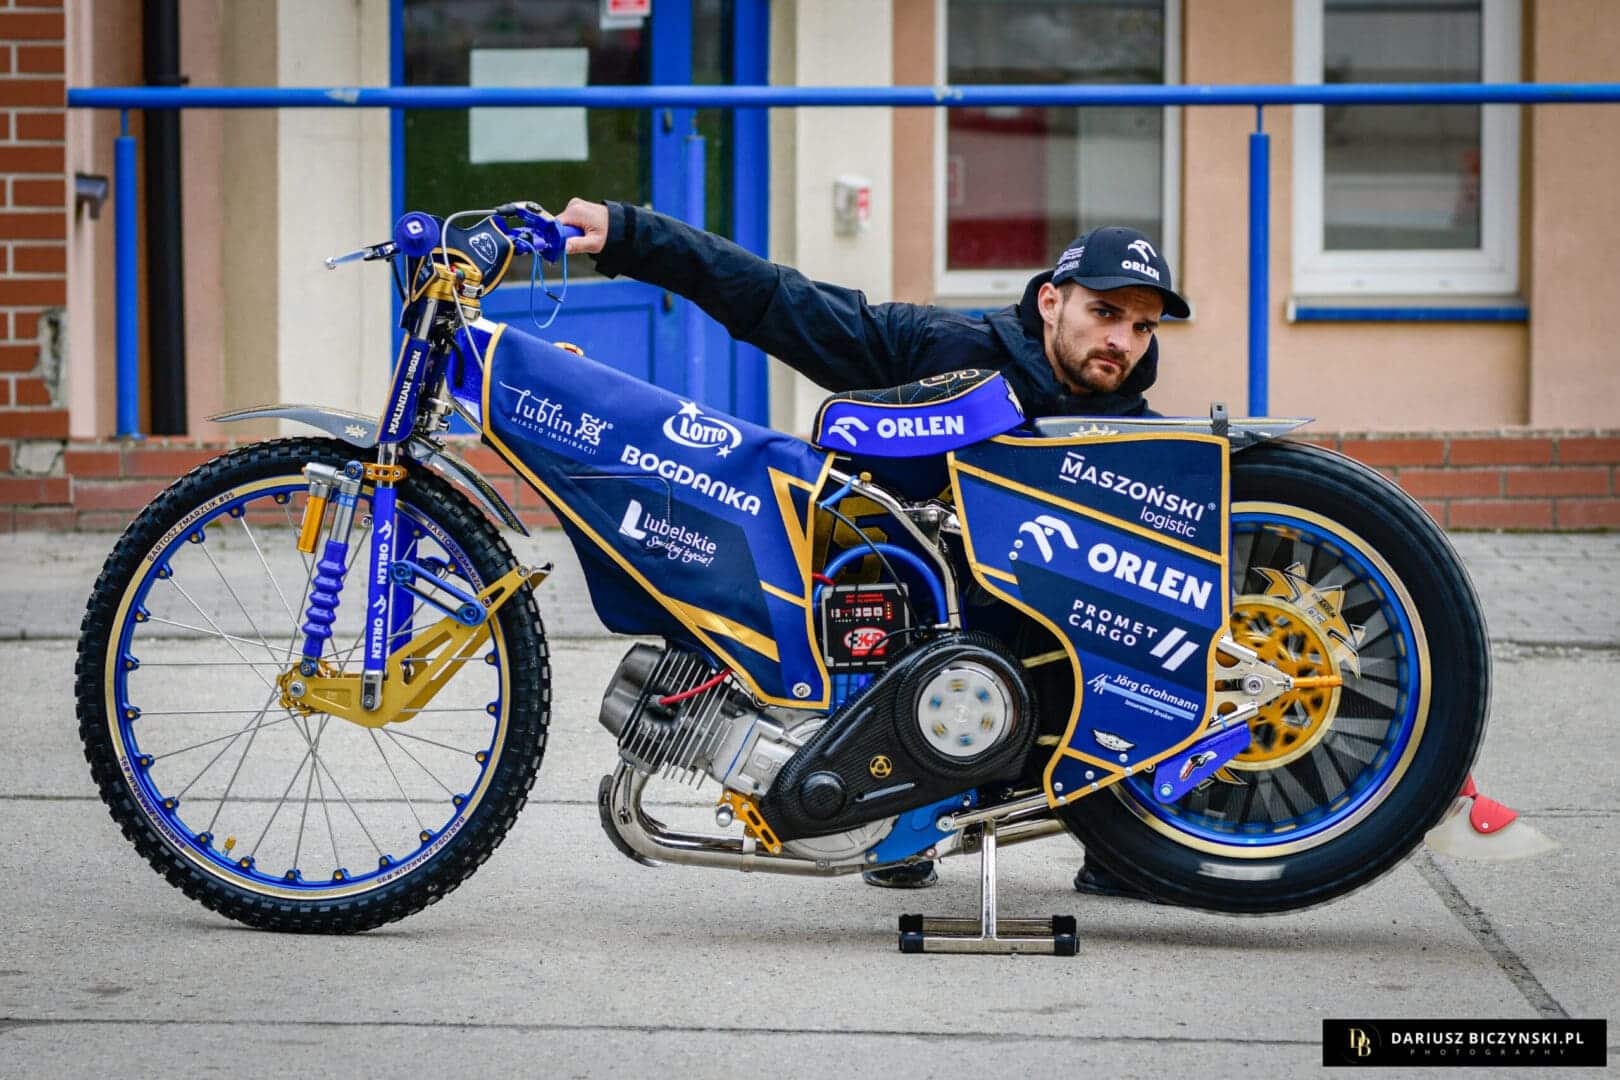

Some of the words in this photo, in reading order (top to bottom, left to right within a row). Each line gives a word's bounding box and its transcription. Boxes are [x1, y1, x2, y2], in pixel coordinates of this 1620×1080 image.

[1121, 260, 1159, 281] ORLEN
[511, 416, 544, 433] MIASTO
[547, 431, 597, 455] INSPIRACJI
[680, 416, 728, 443] LOTTO
[876, 415, 964, 439] ORLEN
[621, 444, 761, 516] BOGDANKA
[1059, 451, 1205, 521] MASZOŃSKI
[147, 527, 178, 562] BARTOSZ
[179, 501, 218, 531] ZMARZLIK
[1140, 506, 1198, 538] logistic
[376, 543, 389, 585] ORLEN
[1087, 543, 1213, 609] ORLEN
[371, 617, 384, 659] ORLEN
[1068, 614, 1137, 647] CARGO
[1071, 599, 1158, 638] PROMET
[1113, 674, 1140, 692] Jörg
[1140, 684, 1199, 712] Grohmann
